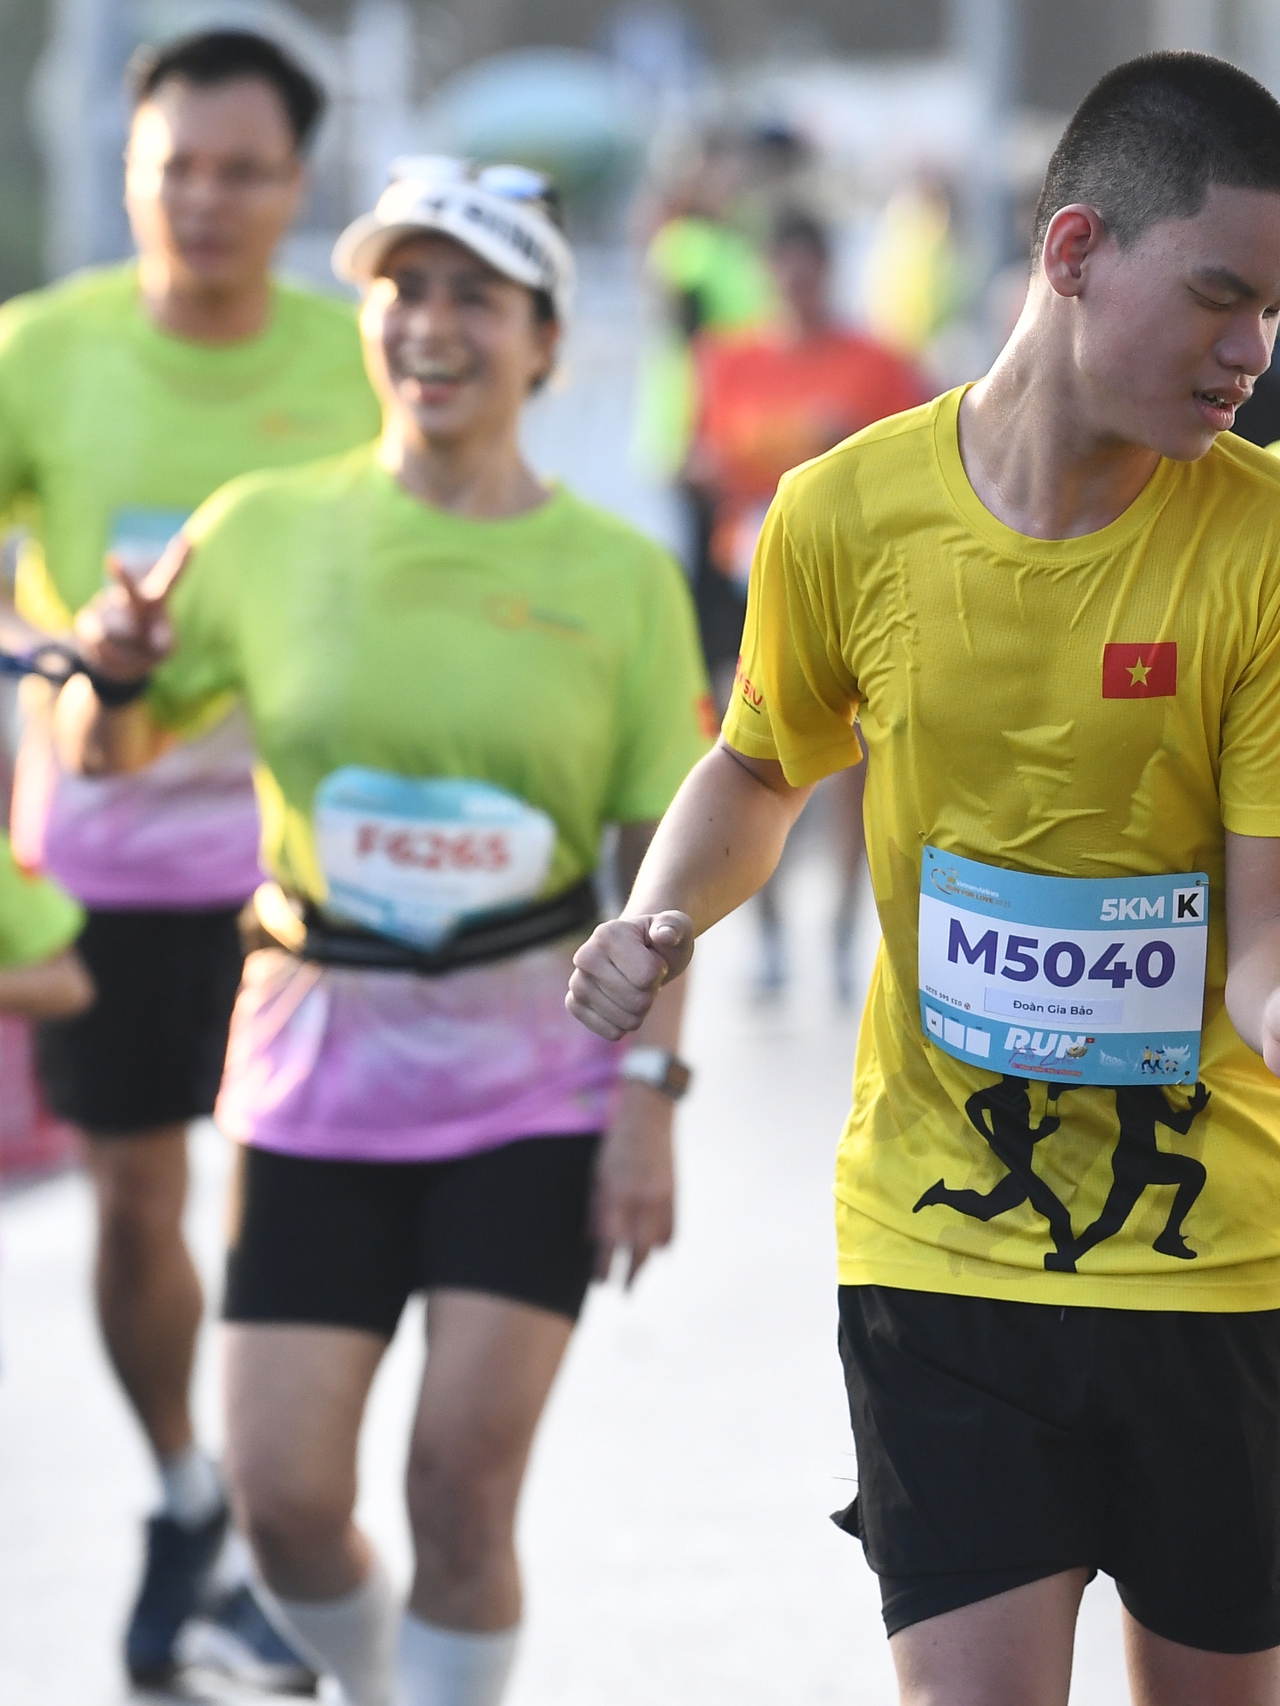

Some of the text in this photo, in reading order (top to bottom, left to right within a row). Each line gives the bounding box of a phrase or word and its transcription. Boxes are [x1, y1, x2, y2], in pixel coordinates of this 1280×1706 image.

[1100, 896, 1165, 922] 5KM
[1177, 893, 1200, 919] K
[947, 917, 1175, 989] M5040
[1013, 1000, 1094, 1016] Đoàn Gia Bảo
[1003, 1027, 1087, 1059] RUN
